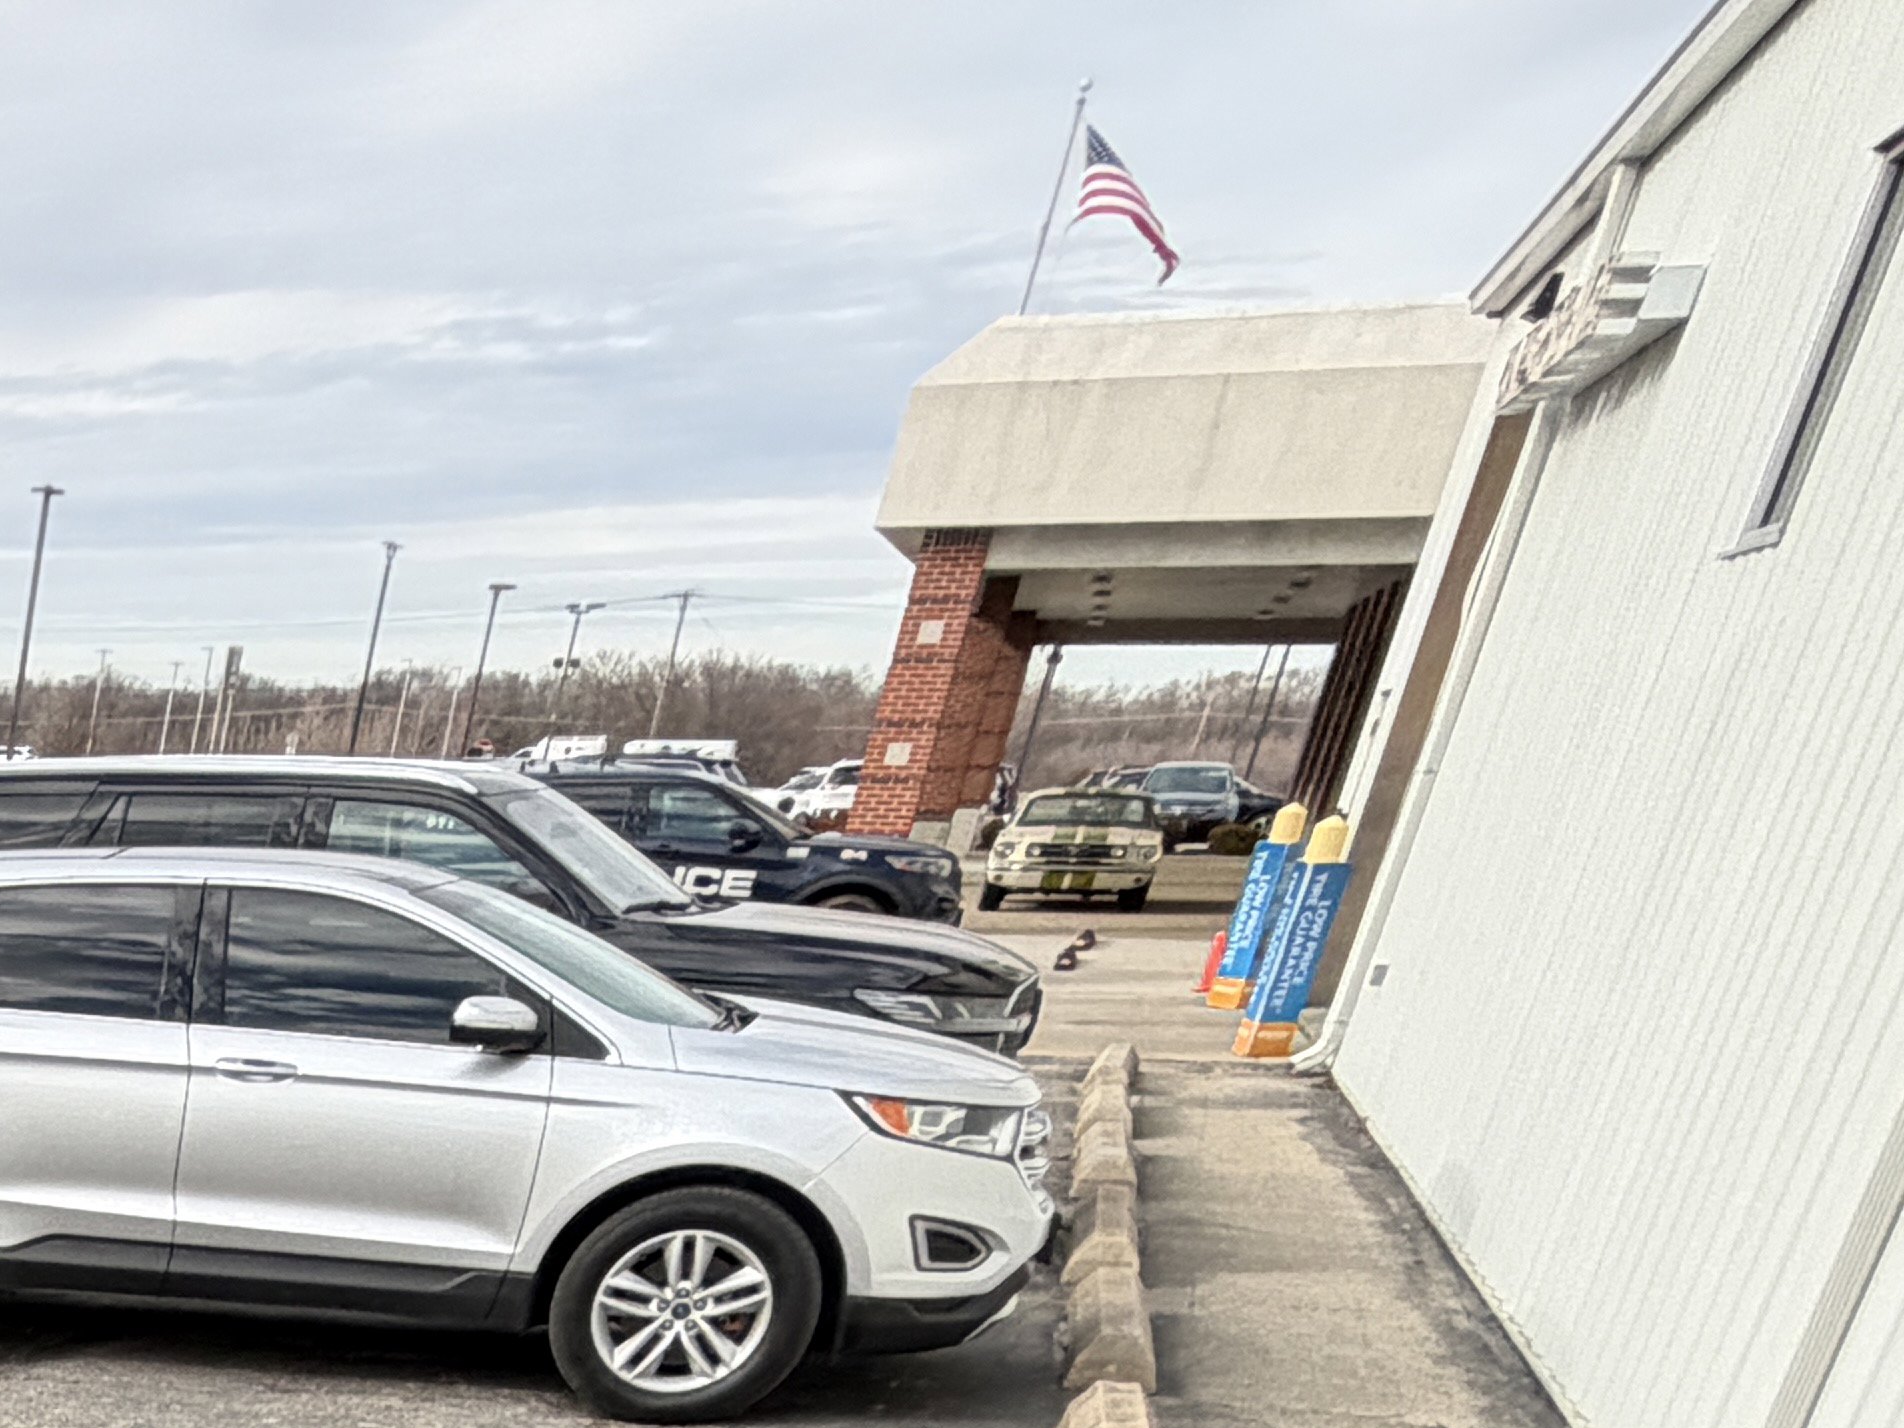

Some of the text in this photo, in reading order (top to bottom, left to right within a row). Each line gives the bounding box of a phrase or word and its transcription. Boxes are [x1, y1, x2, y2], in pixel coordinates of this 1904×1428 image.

[673, 866, 758, 898] ICE
[1305, 872, 1329, 907] TIRE
[1292, 899, 1332, 985] LOW PRICE
